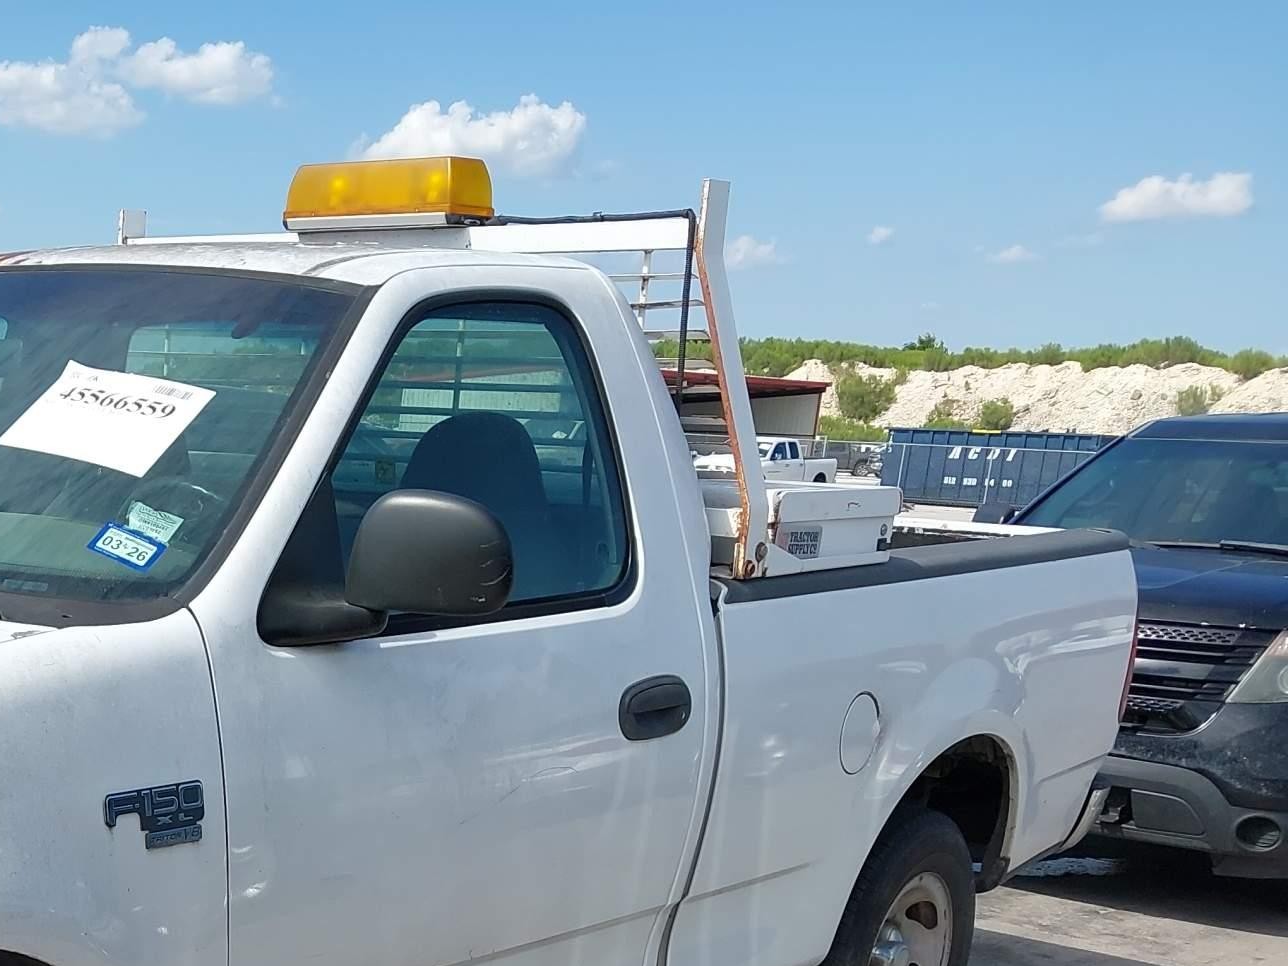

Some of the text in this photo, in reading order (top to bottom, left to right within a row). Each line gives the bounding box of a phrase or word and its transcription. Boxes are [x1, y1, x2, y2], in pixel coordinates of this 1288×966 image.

[59, 386, 176, 419] 45566559
[790, 531, 819, 543] TRACTOR
[102, 535, 123, 550] 03
[126, 546, 149, 562] 26
[788, 543, 810, 555] SUPPLY
[156, 813, 193, 826] XL
[183, 826, 201, 842] V8
